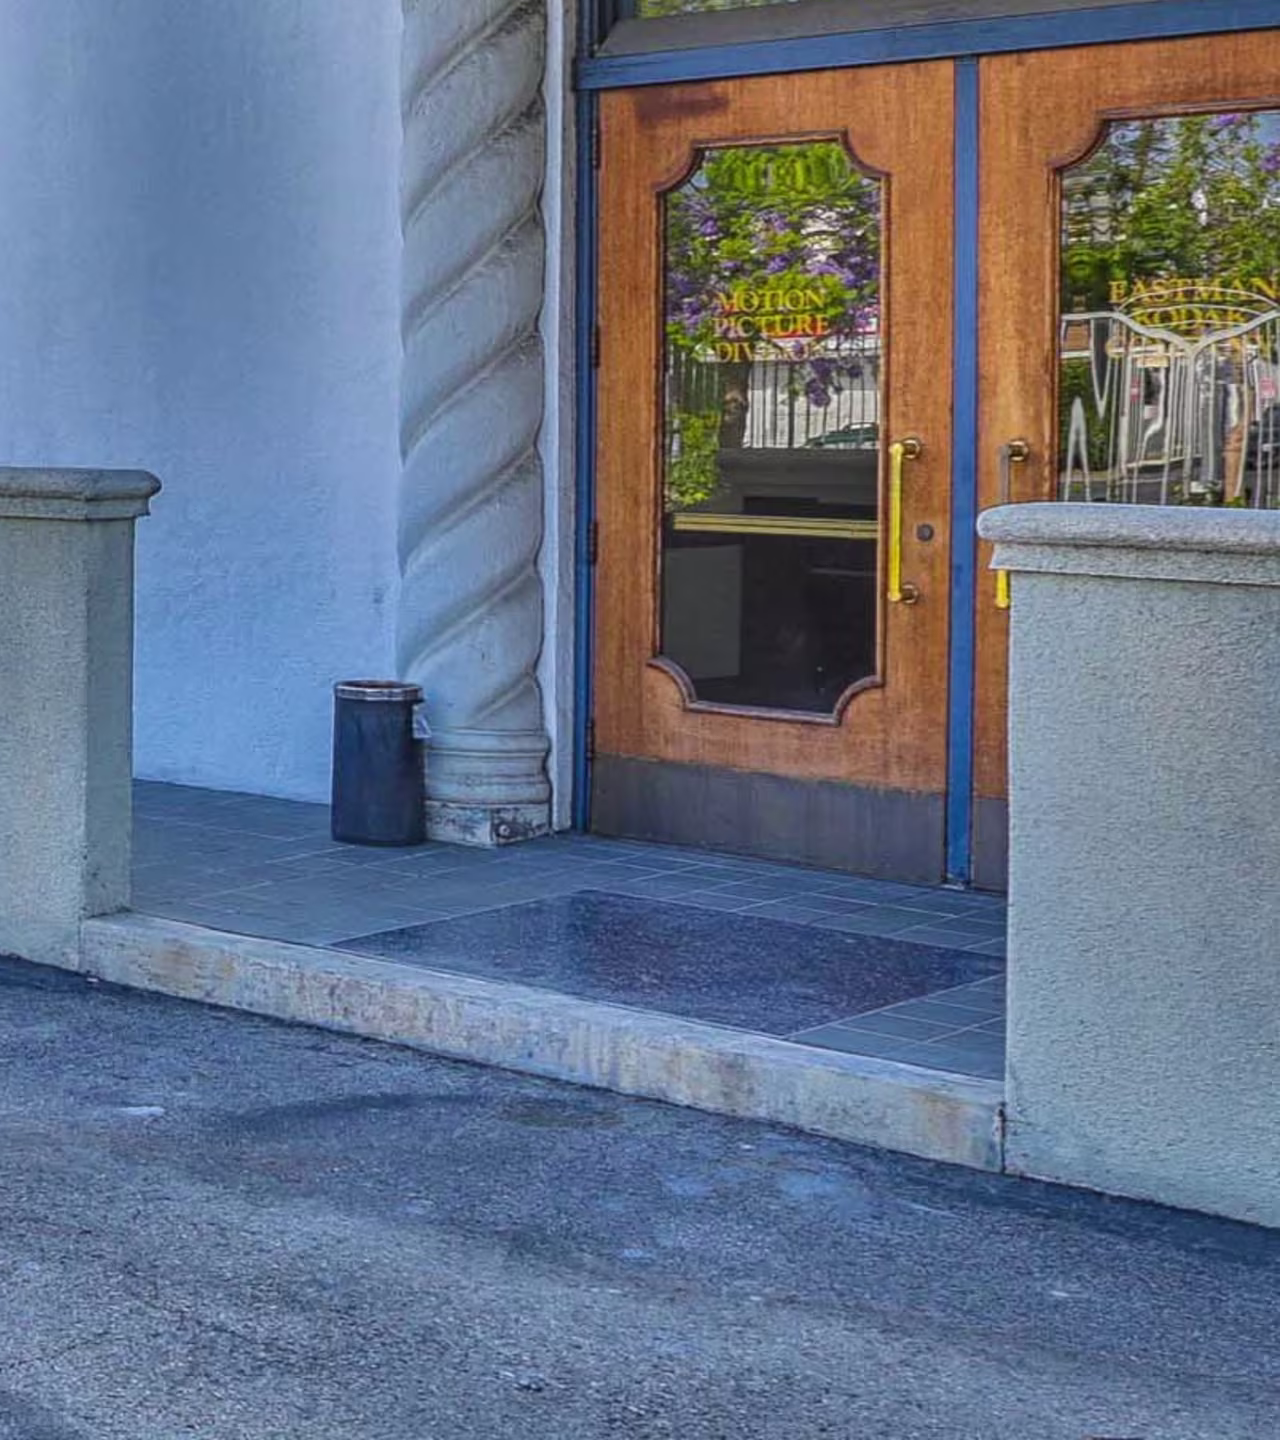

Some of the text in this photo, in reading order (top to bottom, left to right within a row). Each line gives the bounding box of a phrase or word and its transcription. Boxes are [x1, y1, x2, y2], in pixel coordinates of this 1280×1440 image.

[714, 288, 826, 312] MOTION
[1108, 276, 1280, 304] EASTMAN
[711, 313, 832, 338] PICTURE
[1130, 306, 1247, 331] KODAK
[715, 340, 826, 363] DIVON
